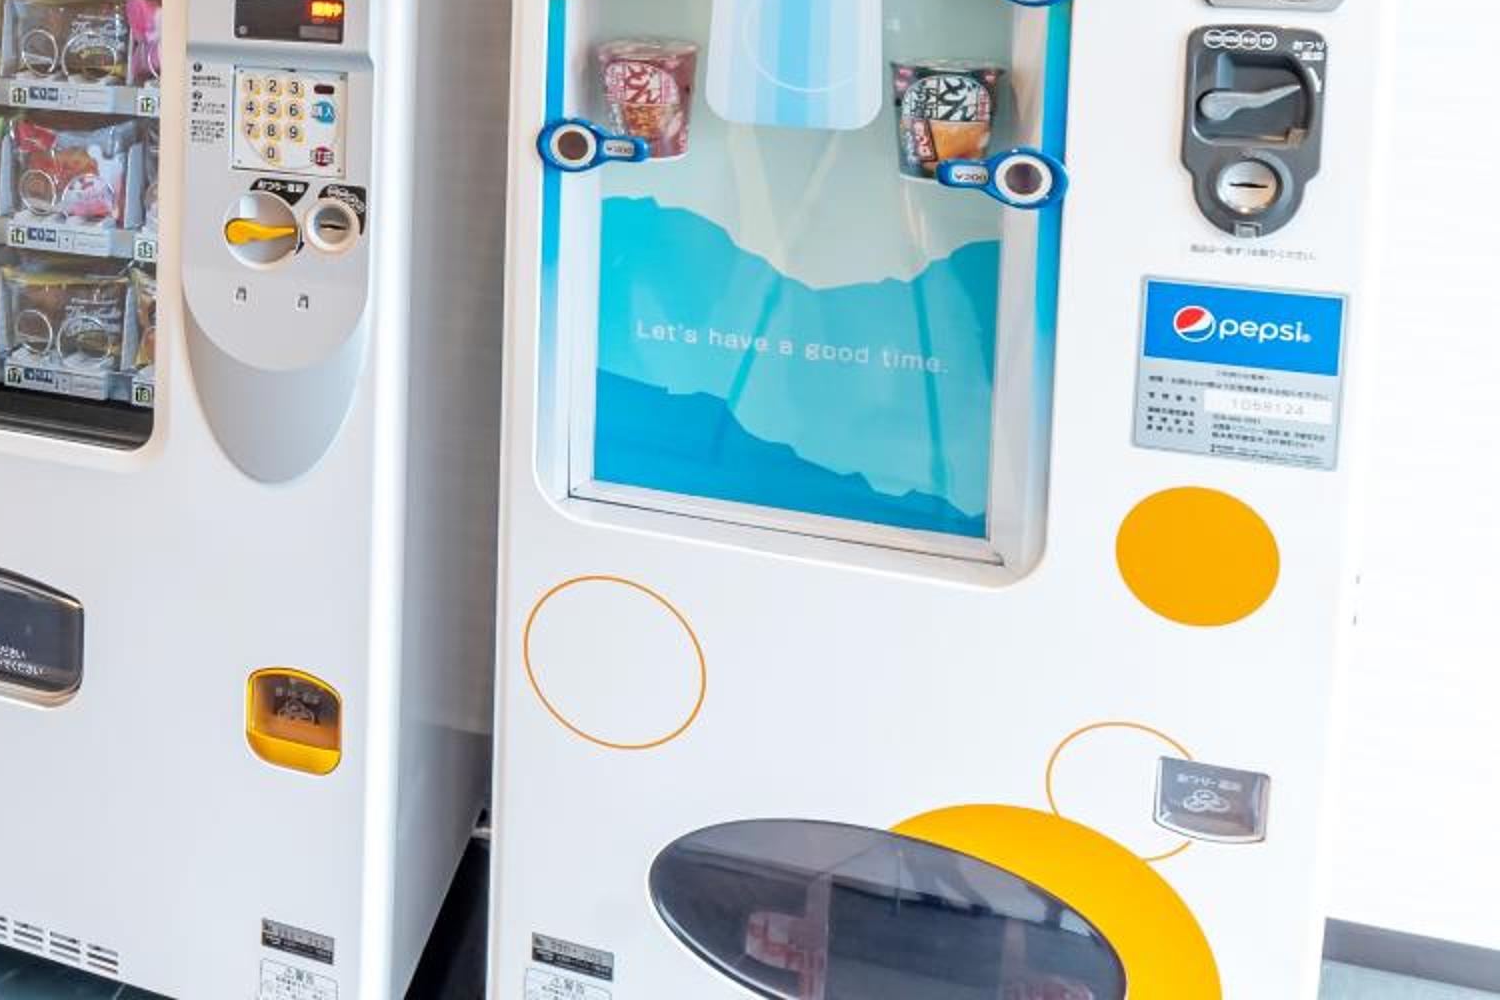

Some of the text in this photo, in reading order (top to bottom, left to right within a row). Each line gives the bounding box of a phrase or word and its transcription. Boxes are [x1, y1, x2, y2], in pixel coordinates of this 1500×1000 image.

[248, 79, 299, 95] 1 2 3
[246, 101, 298, 117] 4 5 6
[246, 123, 298, 138] 7 8 9
[267, 147, 275, 159] 0
[1219, 318, 1302, 344] pepsi
[635, 319, 950, 375] Let's have a good time.
